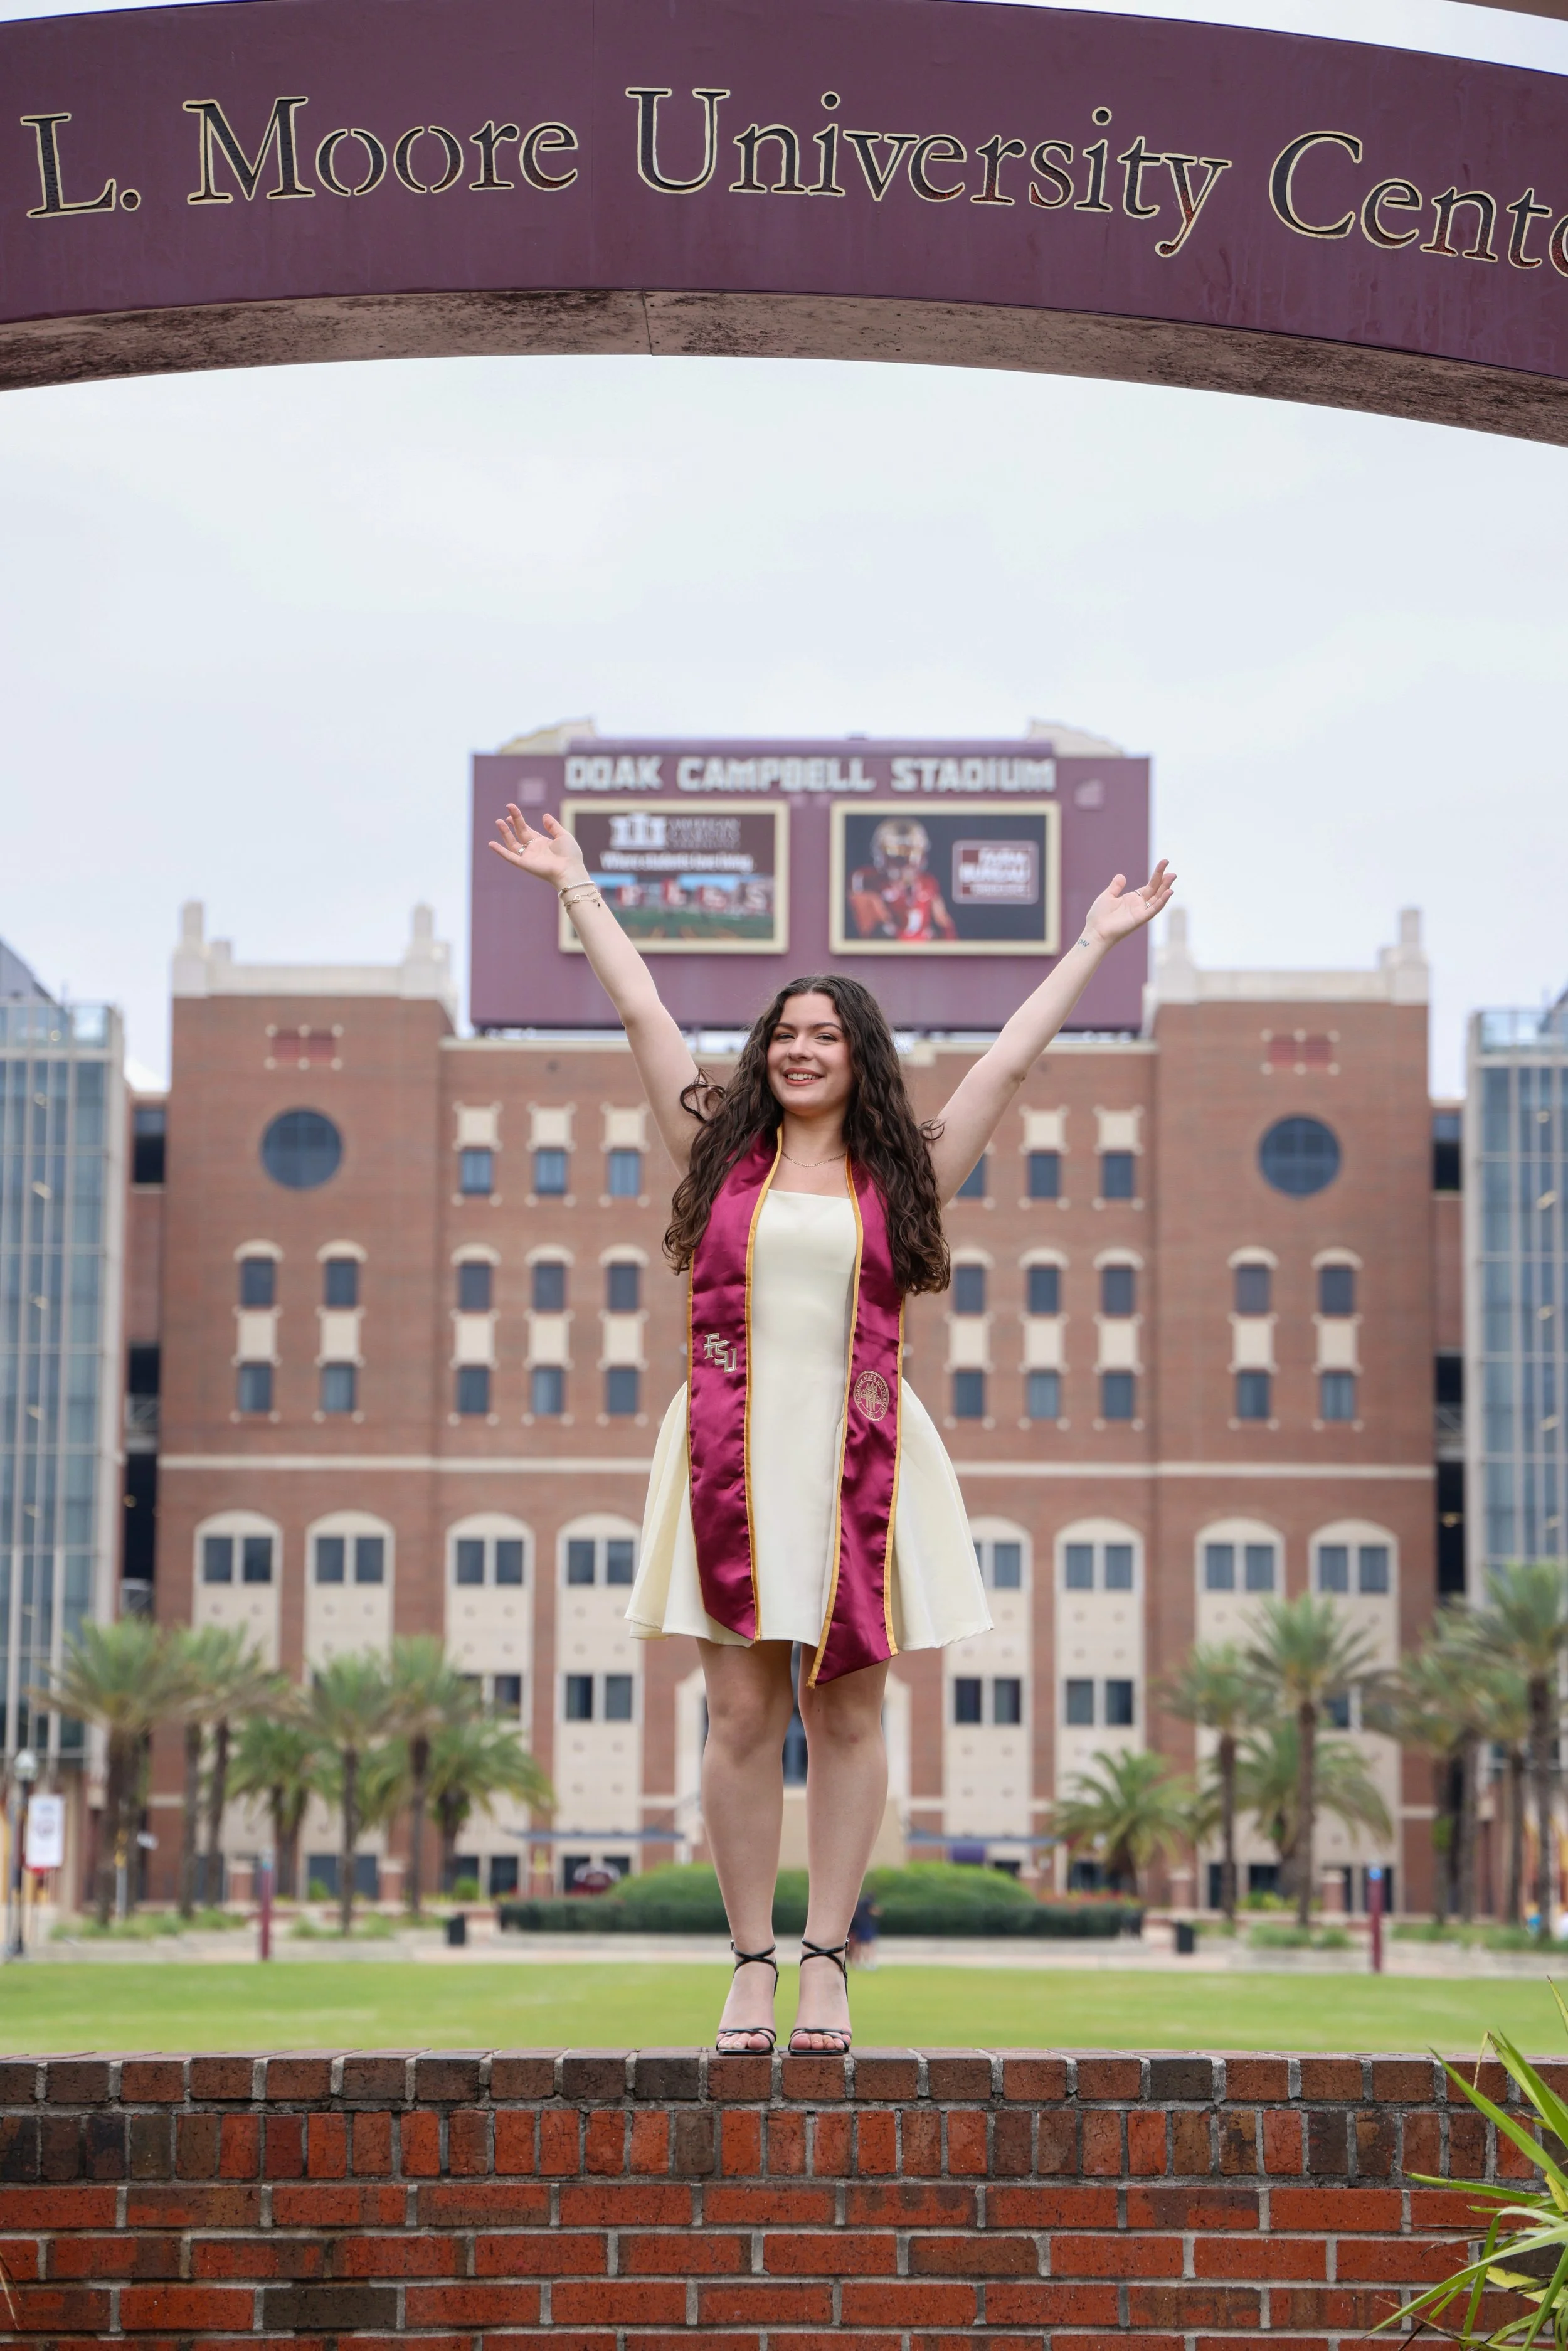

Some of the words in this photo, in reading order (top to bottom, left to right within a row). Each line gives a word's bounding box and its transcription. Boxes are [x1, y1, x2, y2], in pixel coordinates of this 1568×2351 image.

[20, 112, 142, 219] L.
[182, 95, 579, 206] Moore
[625, 87, 1232, 258] University
[564, 755, 663, 791] DOAK
[675, 756, 877, 792] CAMPBELL
[890, 756, 1057, 793] STADIUM
[703, 1332, 737, 1373] FSU
[856, 1379, 864, 1405] FLORIDA
[877, 1379, 887, 1414] UNIVERSITY
